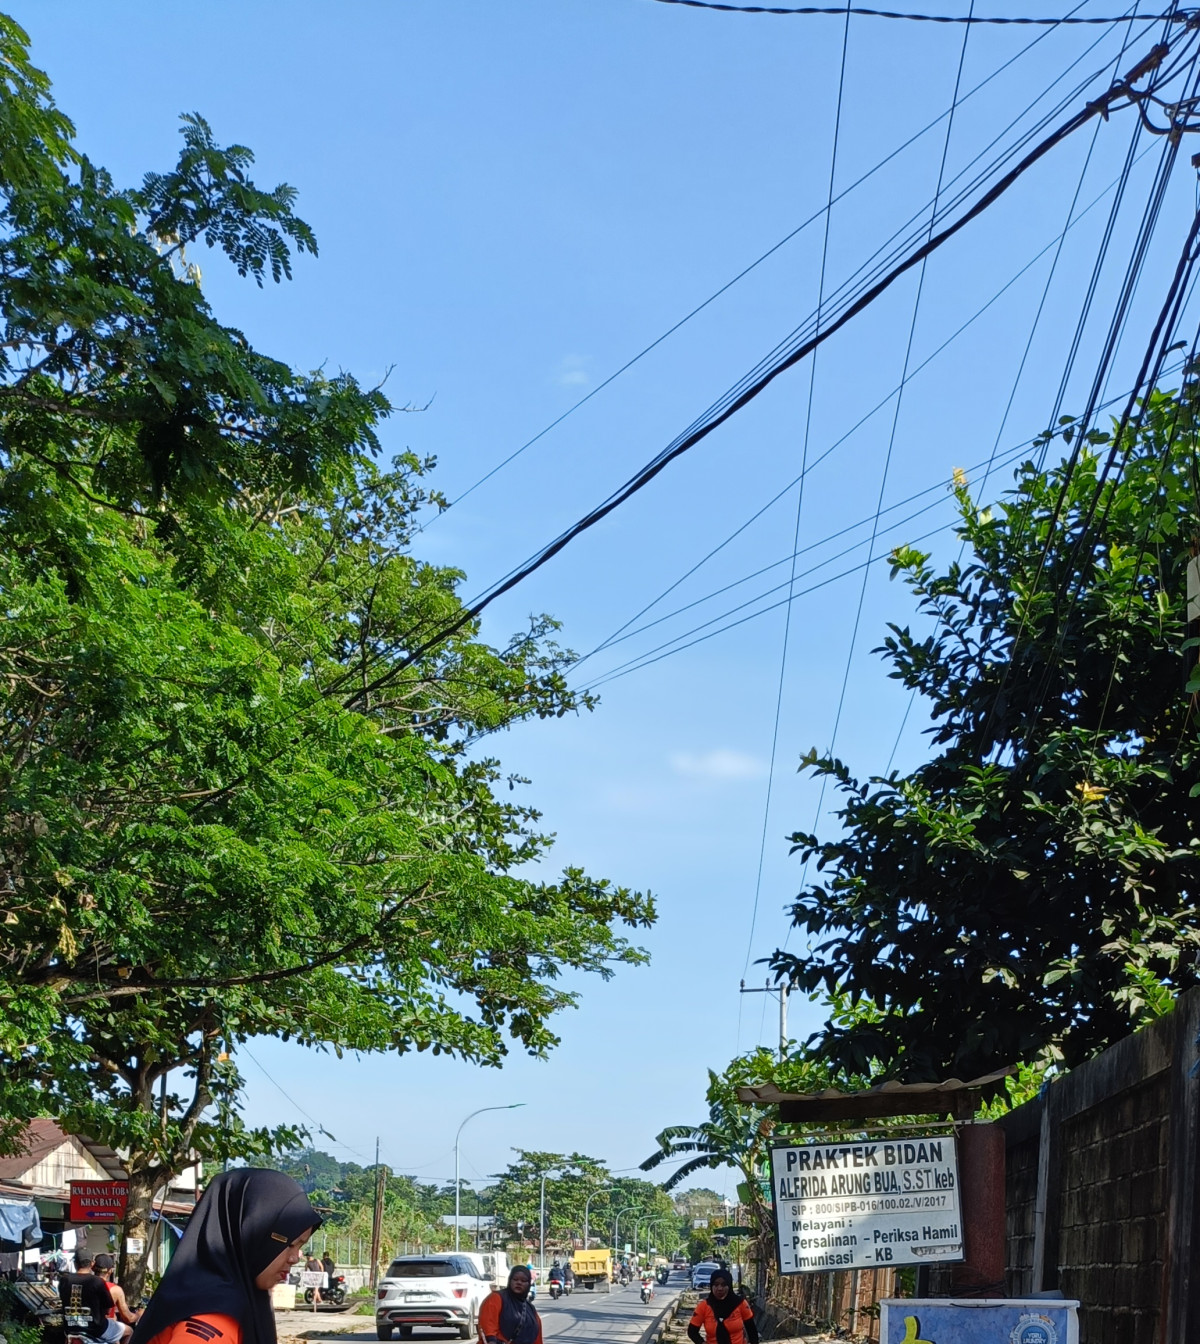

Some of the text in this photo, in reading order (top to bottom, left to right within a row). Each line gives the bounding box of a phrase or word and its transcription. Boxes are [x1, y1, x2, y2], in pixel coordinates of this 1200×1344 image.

[786, 1142, 943, 1172] PRAKTEK BIDAN
[780, 1167, 955, 1199] ALFRIDA ARUNG BUA, S.ST keb
[80, 1198, 122, 1207] KHAS BATAK
[791, 1205, 807, 1216] SIP
[791, 1217, 845, 1232] Melayani
[792, 1233, 858, 1250] Persalinan
[873, 1228, 919, 1244] Periksa
[922, 1224, 958, 1241] Hamil
[794, 1250, 854, 1268] Imunisasi
[875, 1247, 893, 1262] KB
